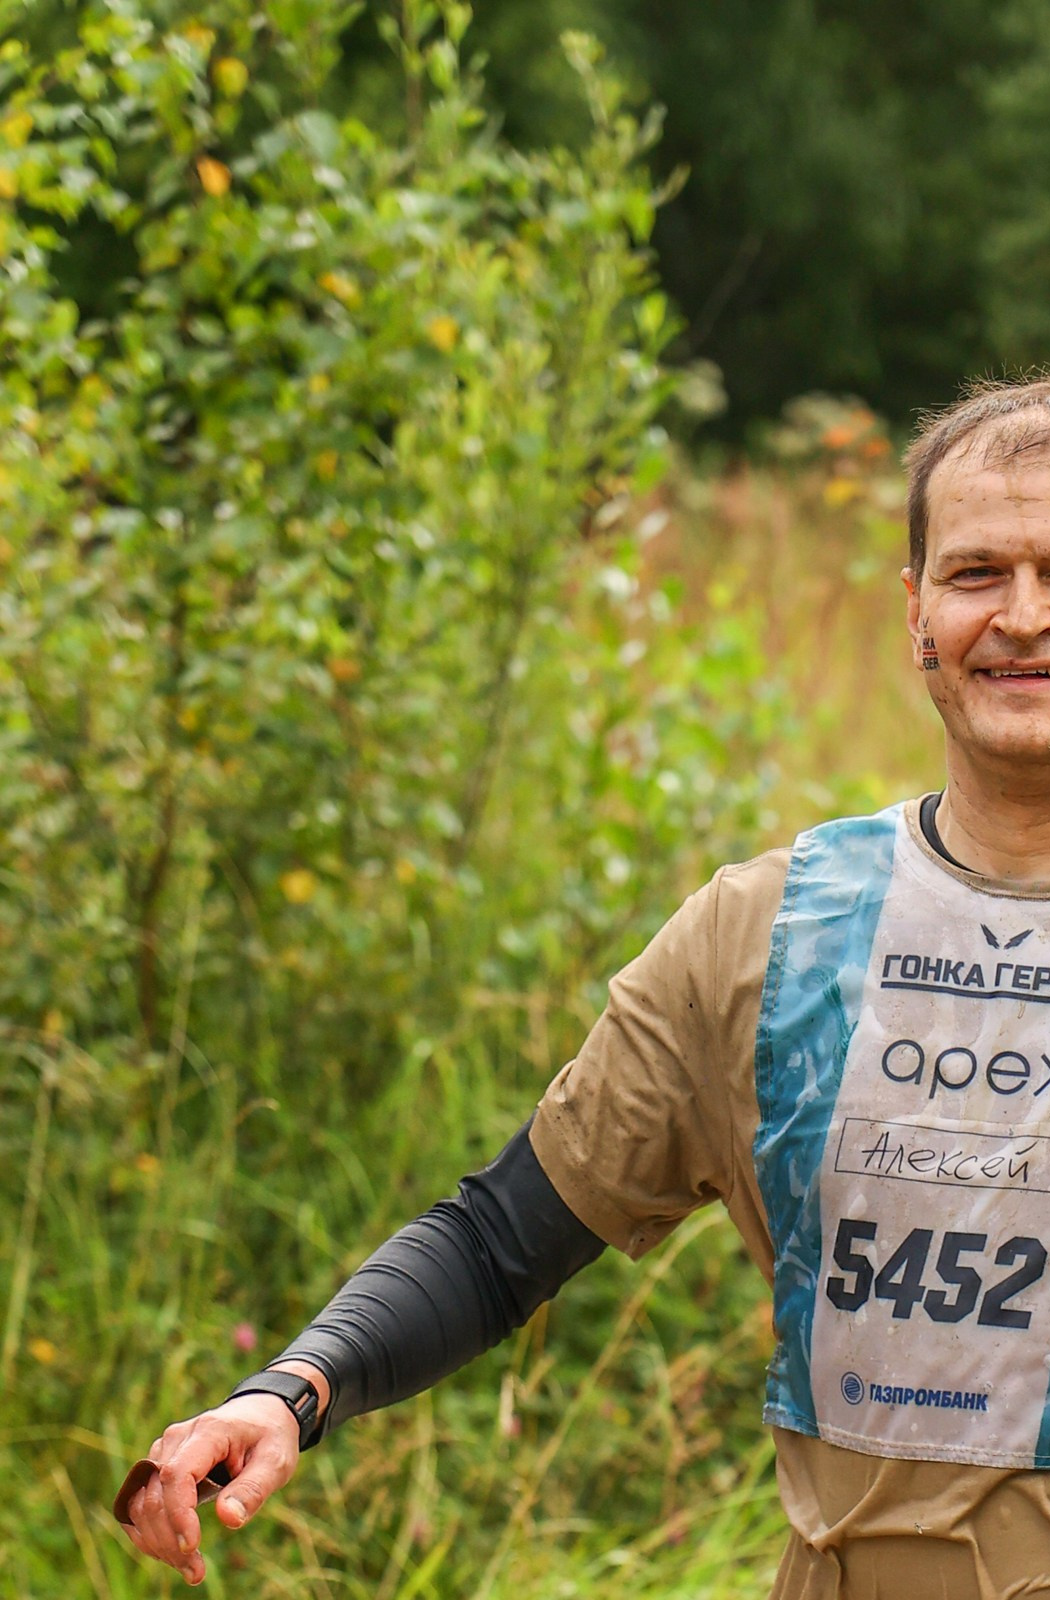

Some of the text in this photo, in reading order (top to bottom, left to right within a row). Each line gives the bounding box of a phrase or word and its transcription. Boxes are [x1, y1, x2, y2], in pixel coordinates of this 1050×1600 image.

[882, 954, 985, 988] ГОНКА
[862, 1131, 1037, 1183] Алексей
[826, 1218, 1048, 1329] 5452
[870, 1384, 988, 1411] ГАЗПРОМБАНК
